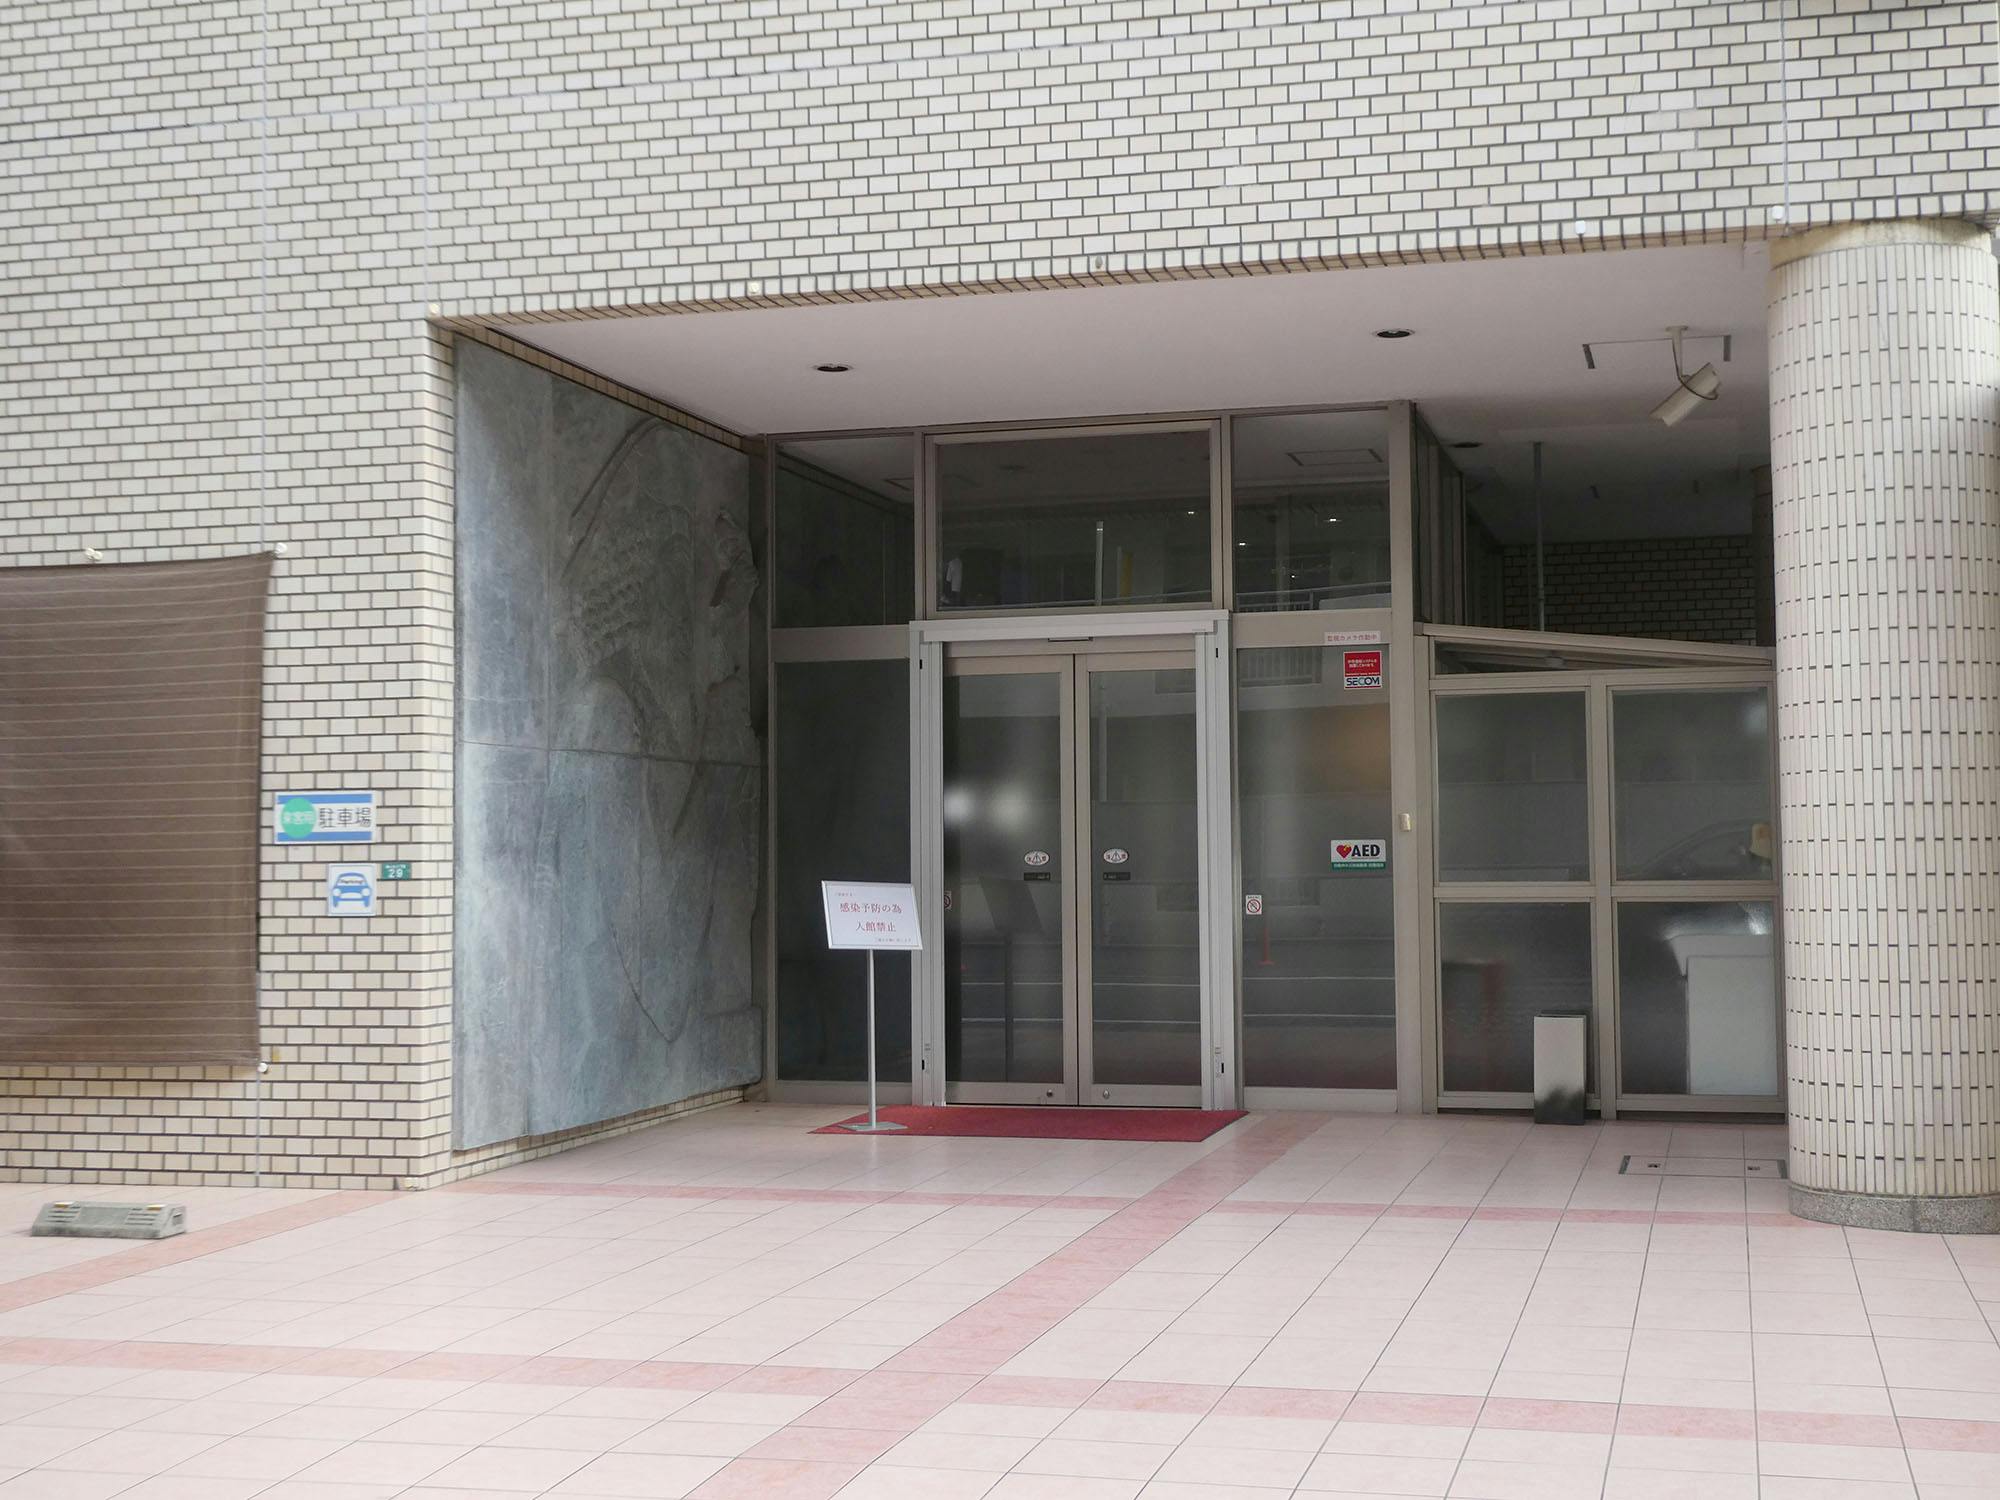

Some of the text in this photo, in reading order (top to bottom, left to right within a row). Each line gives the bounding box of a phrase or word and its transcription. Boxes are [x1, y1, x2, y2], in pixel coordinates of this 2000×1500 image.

[1346, 677, 1380, 686] SECOM
[319, 807, 372, 828] 駐車場
[1351, 844, 1380, 857] AED
[840, 902, 902, 914] 感染予防の為
[856, 921, 897, 932] 入館禁止
